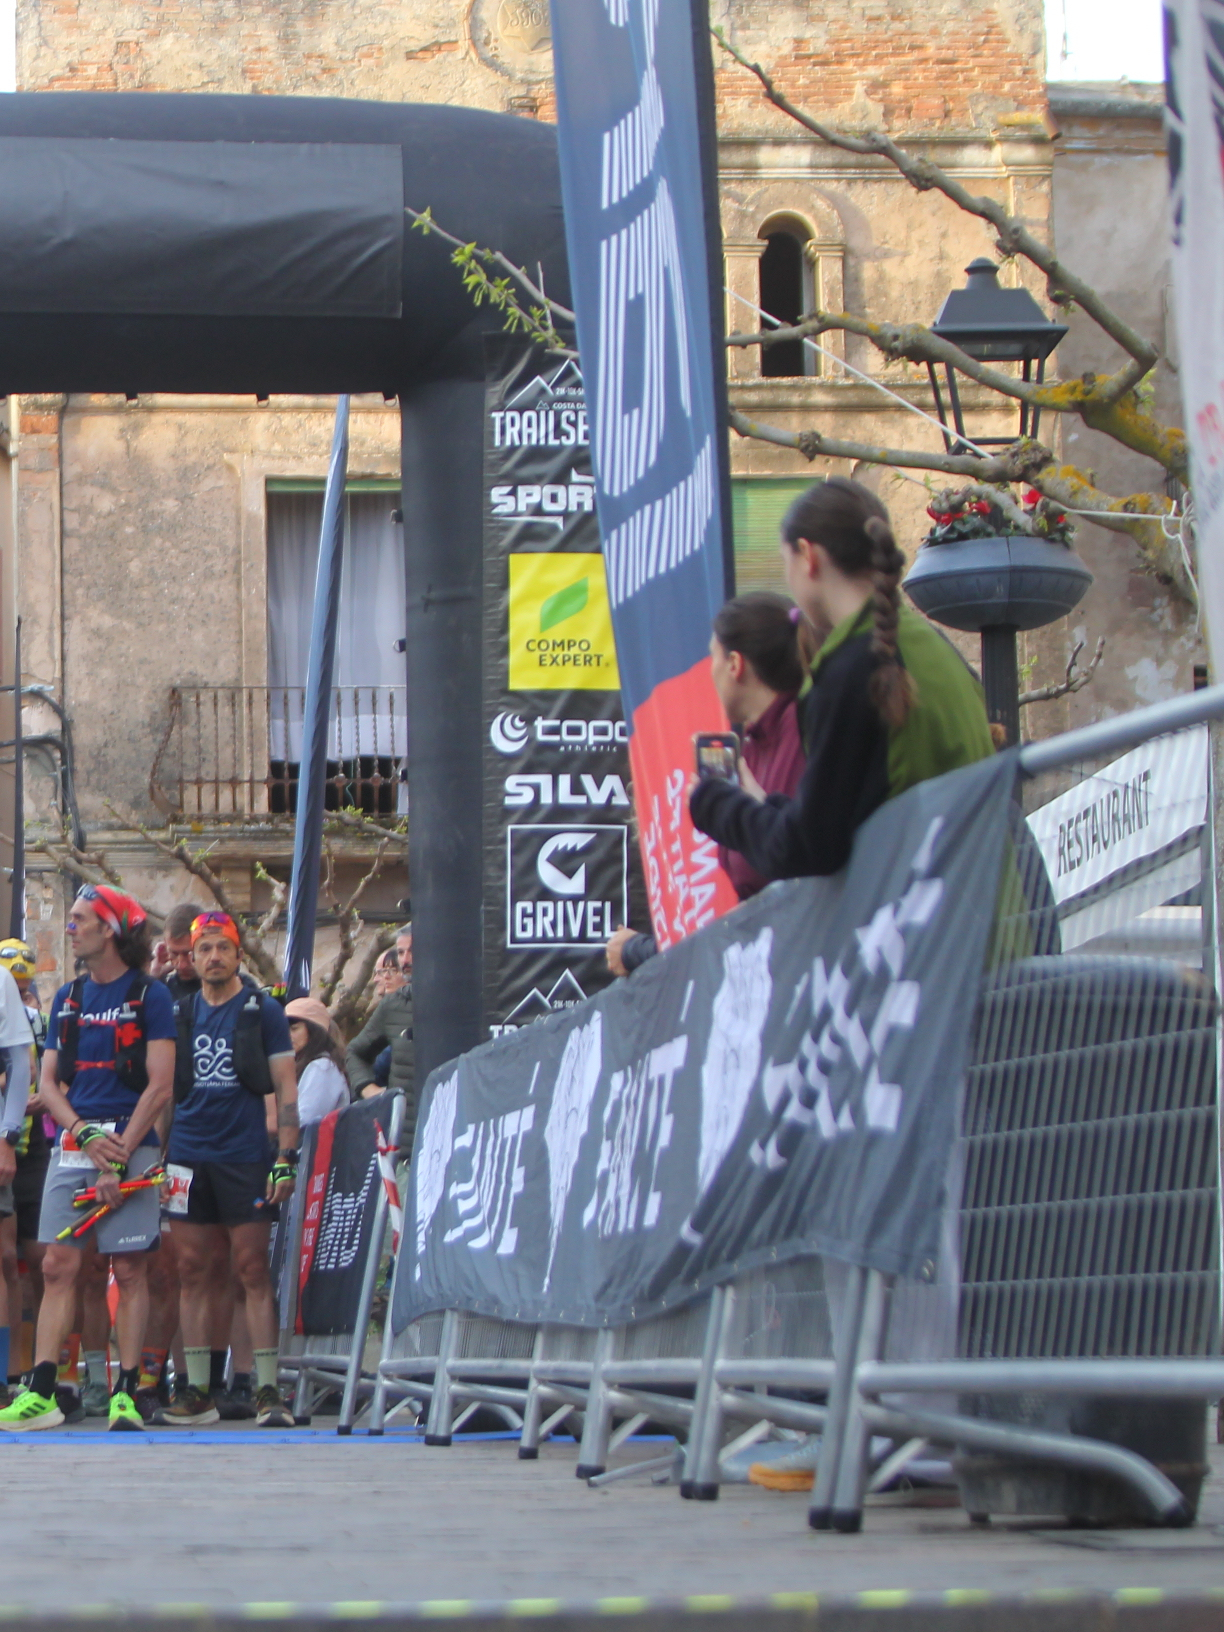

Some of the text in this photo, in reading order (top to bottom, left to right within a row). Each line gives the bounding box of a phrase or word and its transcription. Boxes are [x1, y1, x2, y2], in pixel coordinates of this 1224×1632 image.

[552, 401, 575, 410] COSTA
[491, 410, 590, 447] TRAILSE
[490, 484, 596, 514] SPOR
[526, 638, 592, 652] COMPO
[538, 653, 604, 667] EXPERT
[559, 744, 618, 753] athletic
[503, 773, 630, 805] SILVA
[1057, 769, 1152, 878] RESTAURANT
[515, 900, 615, 939] GRIVEL
